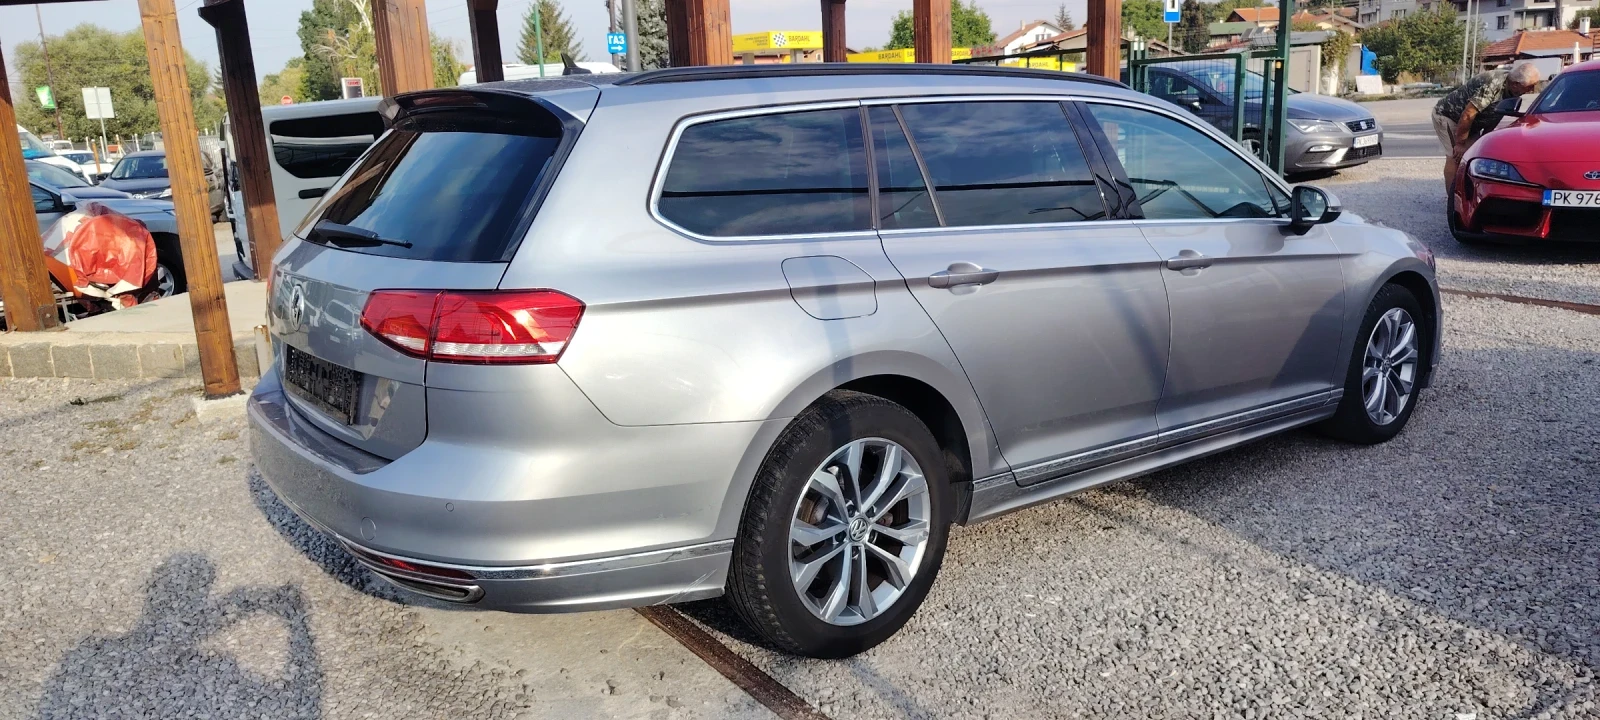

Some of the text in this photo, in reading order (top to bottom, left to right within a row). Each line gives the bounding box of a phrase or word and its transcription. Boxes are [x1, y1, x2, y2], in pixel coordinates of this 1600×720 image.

[608, 35, 625, 45] ГАЗ
[878, 51, 901, 60] BARDAHL
[1553, 192, 1572, 204] PK
[1576, 193, 1600, 205] 976
